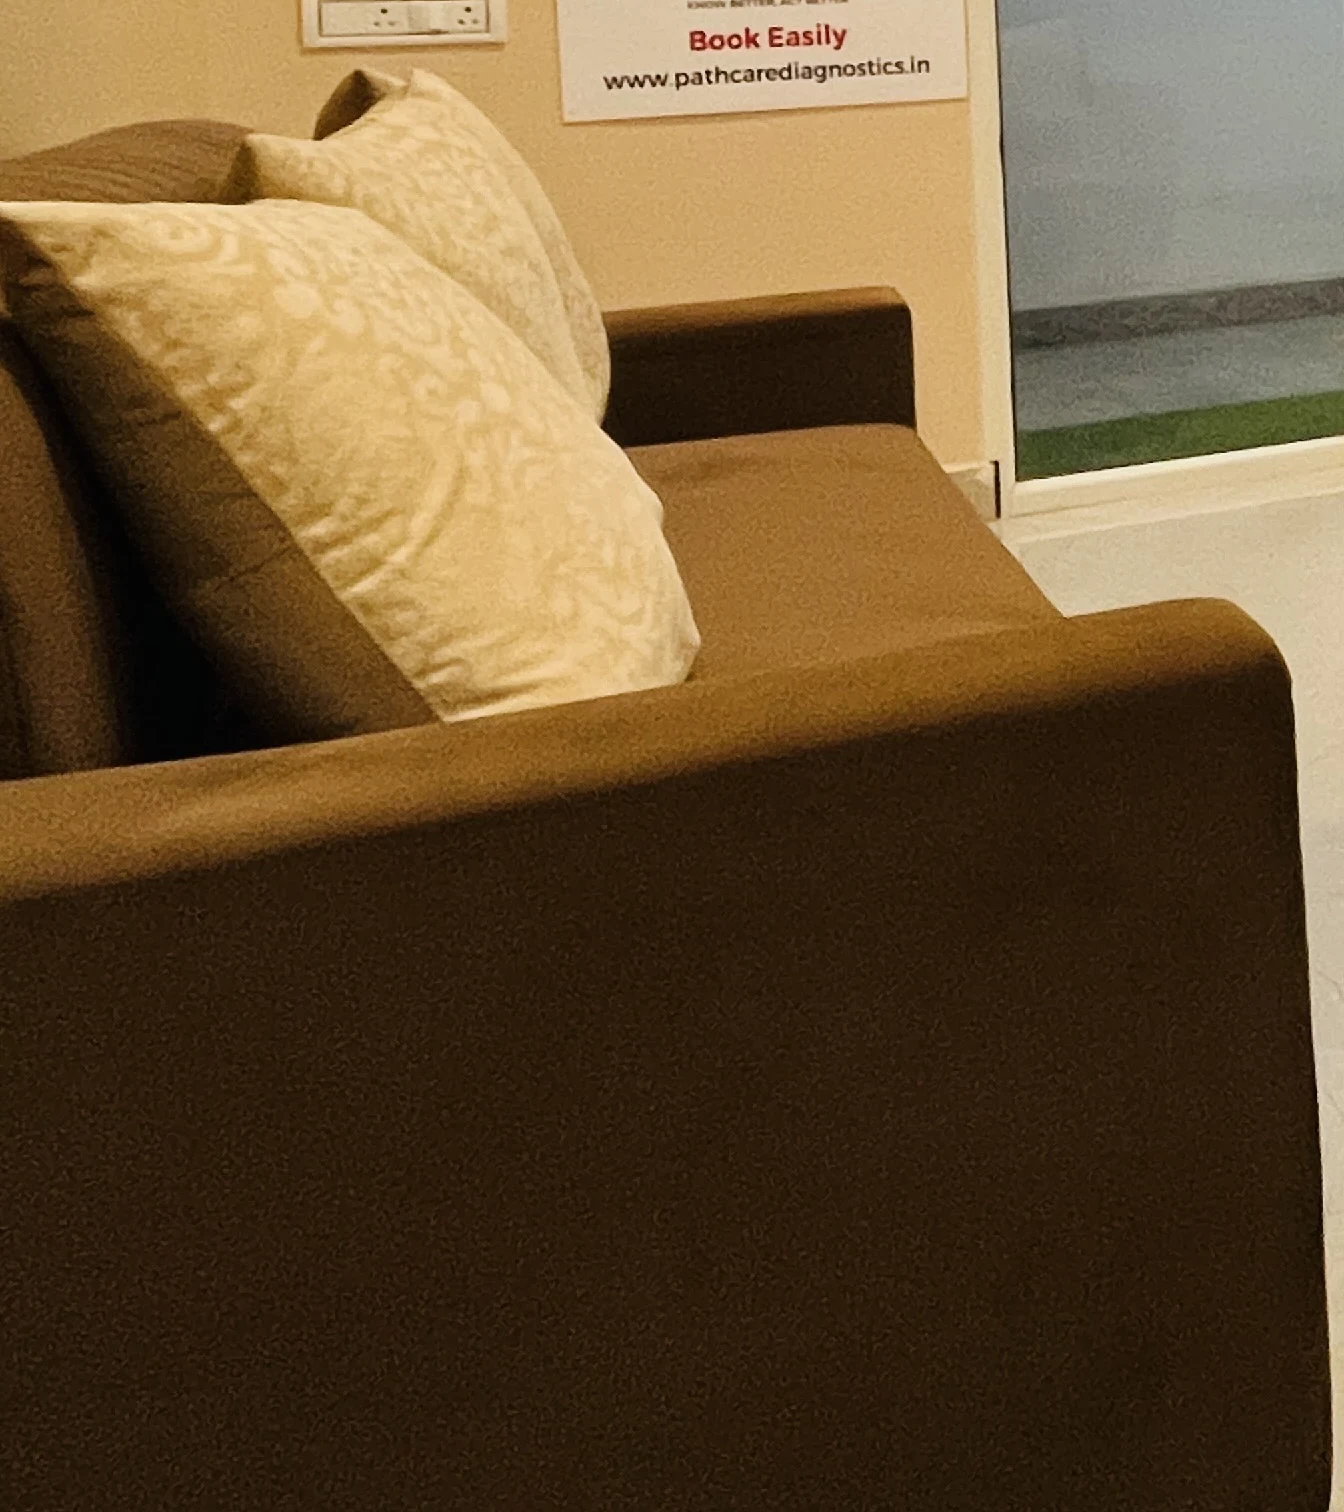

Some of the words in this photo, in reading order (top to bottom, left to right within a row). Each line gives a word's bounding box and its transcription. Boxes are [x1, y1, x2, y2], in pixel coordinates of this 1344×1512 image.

[688, 27, 761, 52] Book
[768, 23, 848, 51] Easily
[602, 55, 931, 92] www.pathcarediagnostics.in
